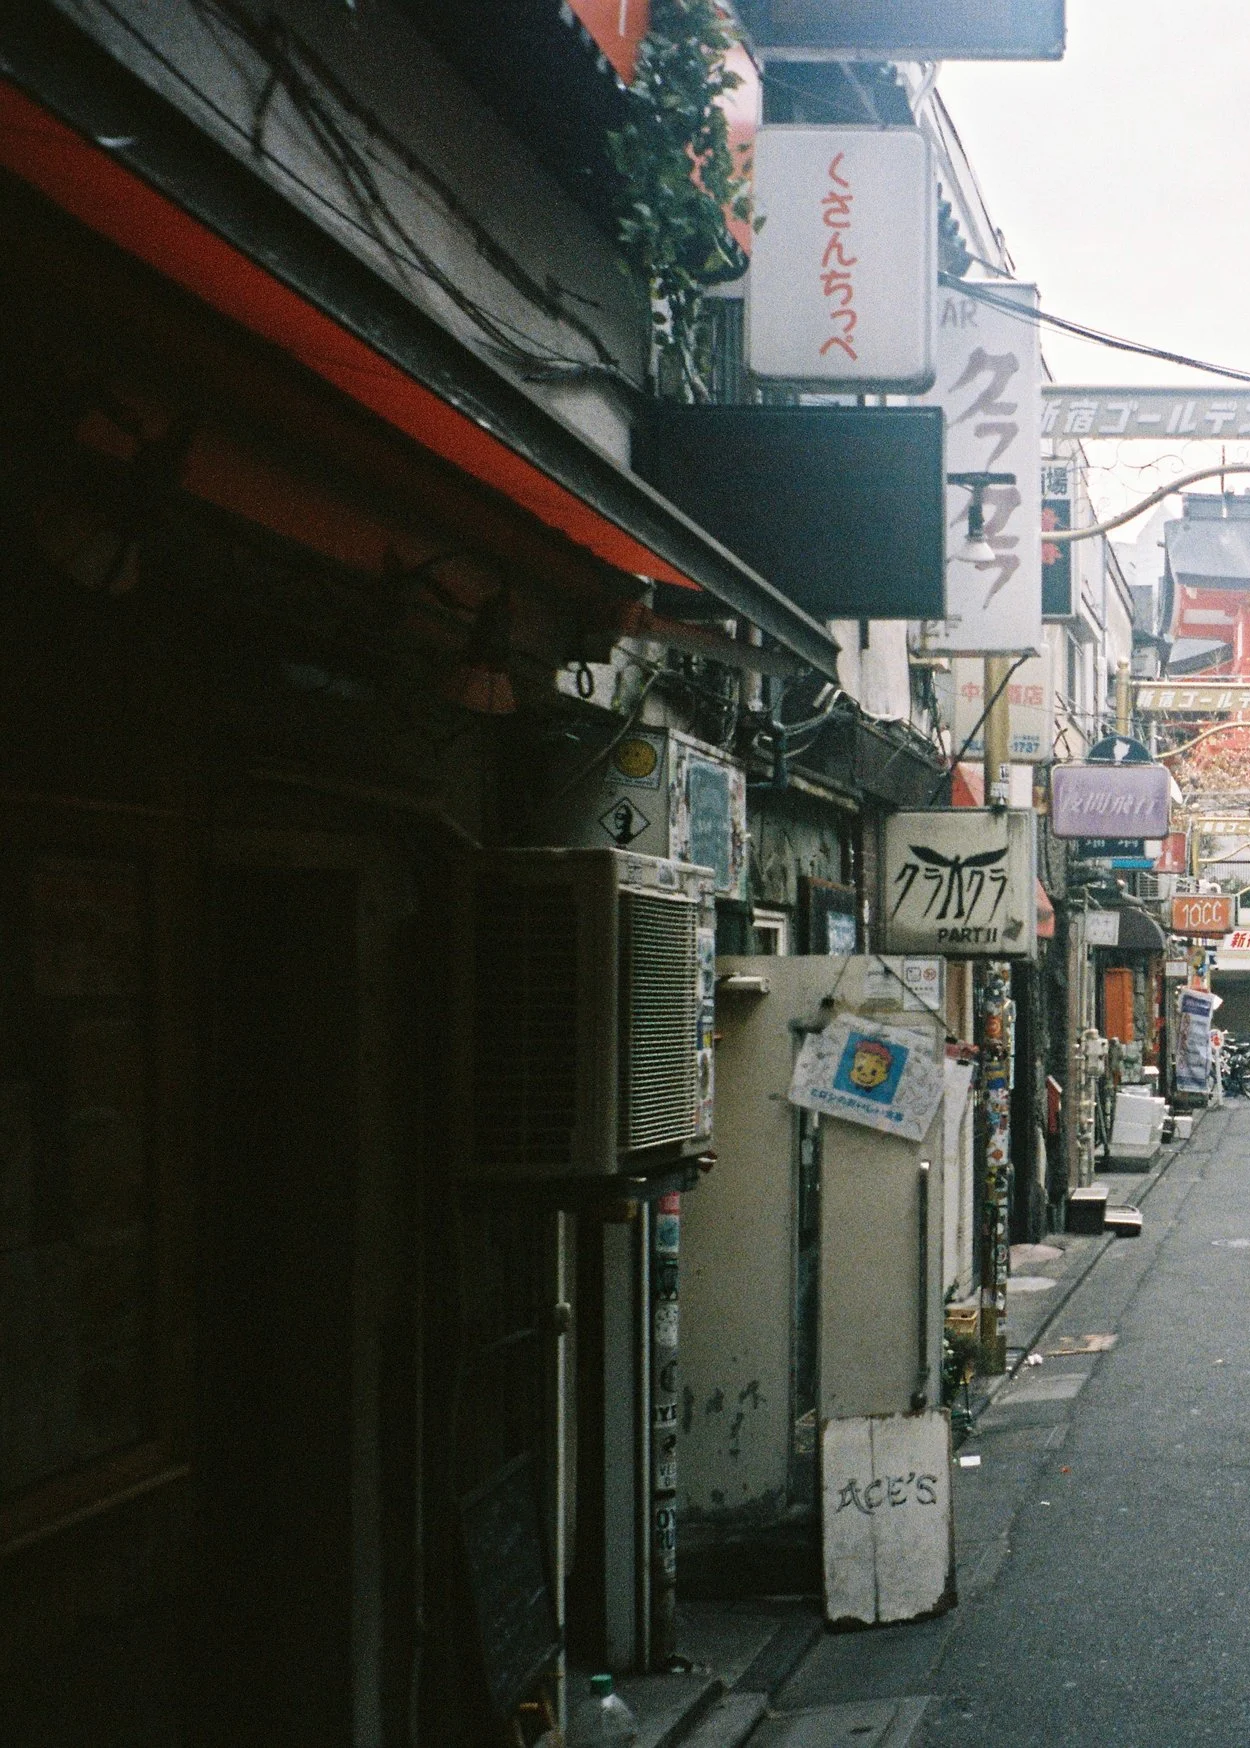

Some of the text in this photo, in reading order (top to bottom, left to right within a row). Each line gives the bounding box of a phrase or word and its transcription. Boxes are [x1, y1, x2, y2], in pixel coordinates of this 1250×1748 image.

[940, 300, 978, 328] AR
[1041, 466, 1068, 495] 場
[834, 1472, 938, 1515] ACE'S
